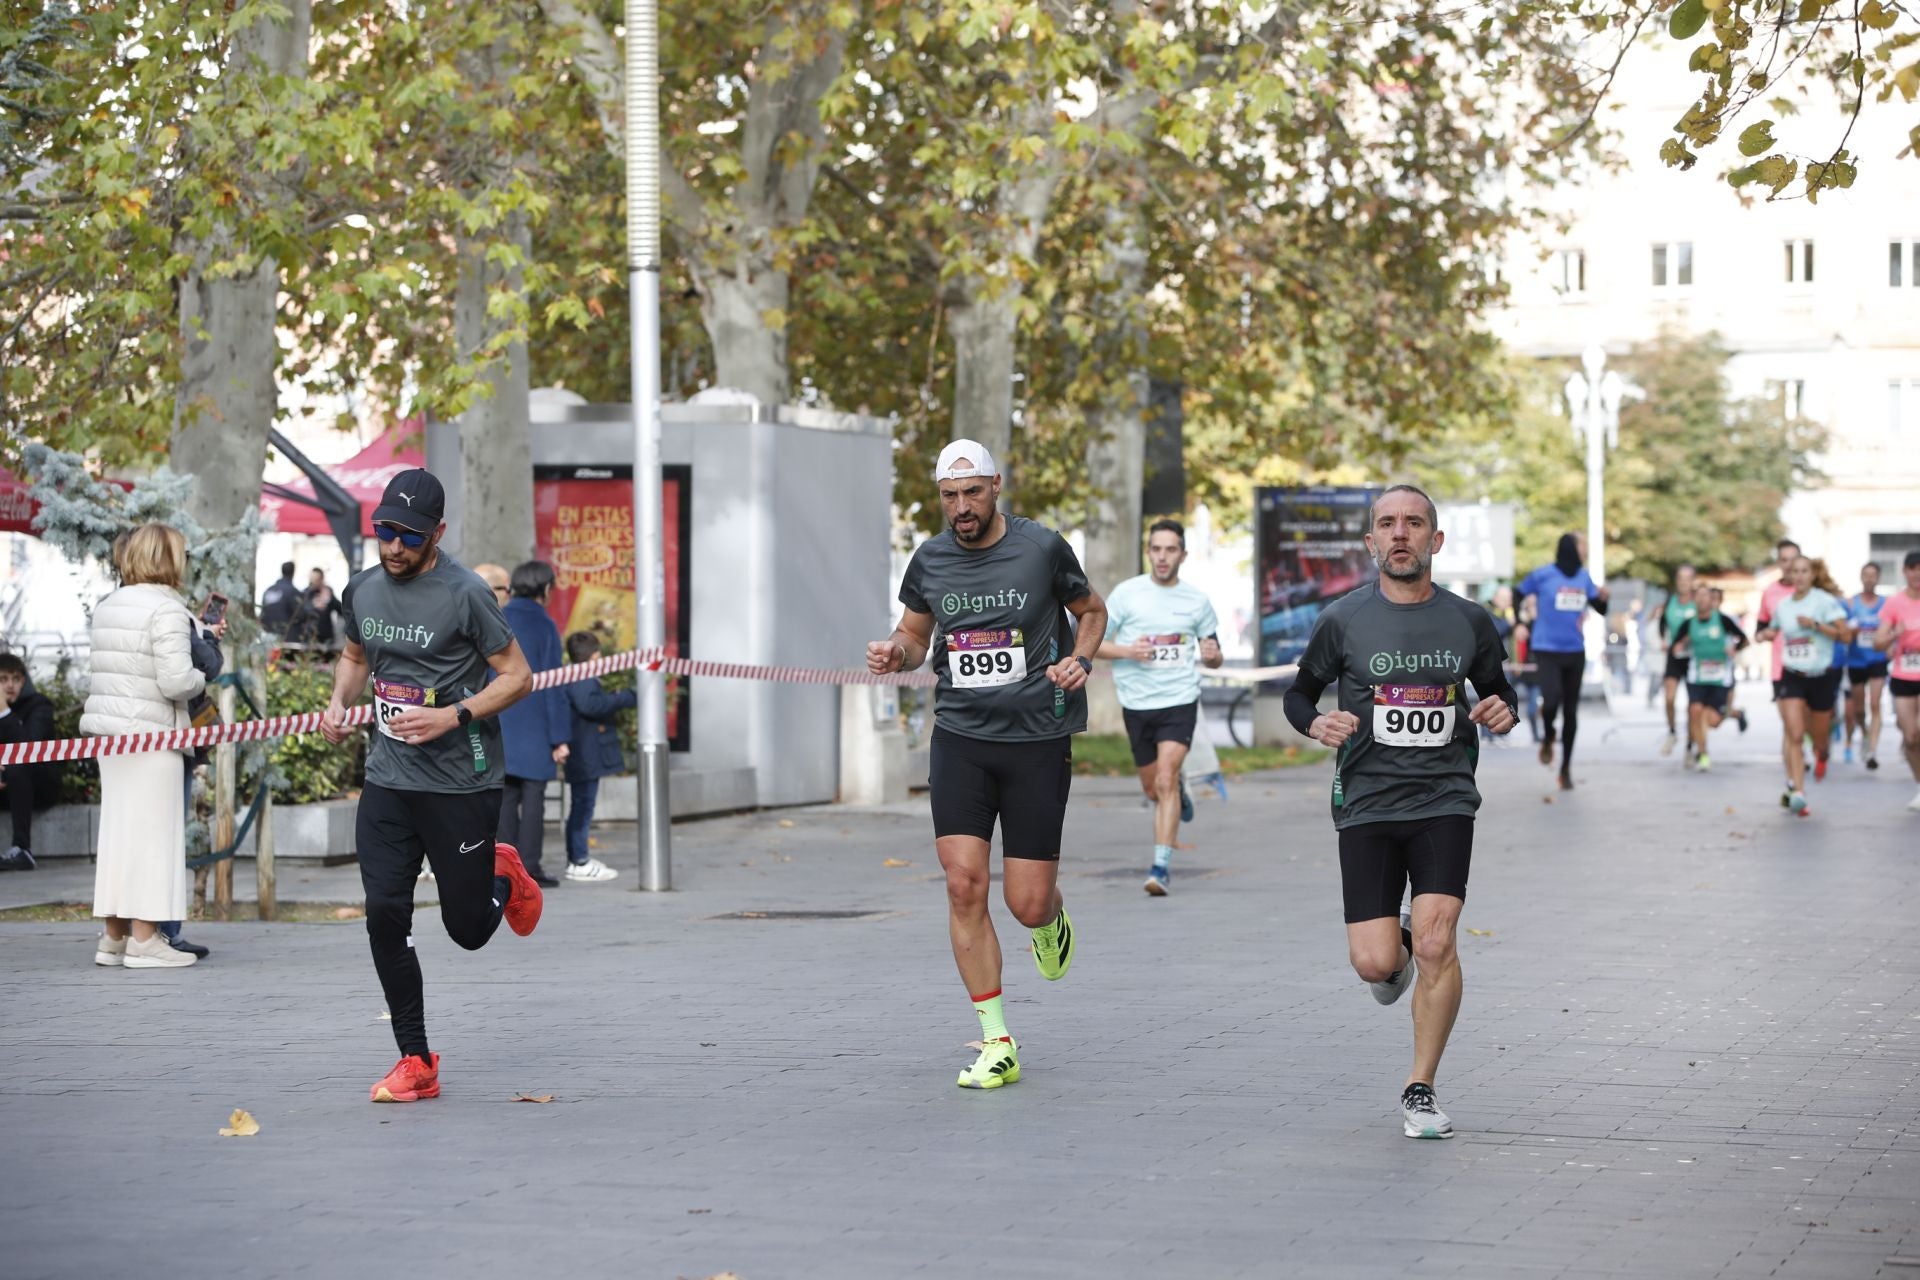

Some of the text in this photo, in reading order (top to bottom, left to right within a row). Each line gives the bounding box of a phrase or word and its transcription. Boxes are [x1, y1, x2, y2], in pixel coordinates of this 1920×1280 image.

[558, 505, 631, 525] EN ESTAS
[552, 526, 634, 546] NAVIDADES
[959, 651, 1013, 676] 899
[1385, 709, 1445, 734] 900
[470, 733, 485, 760] RUN
